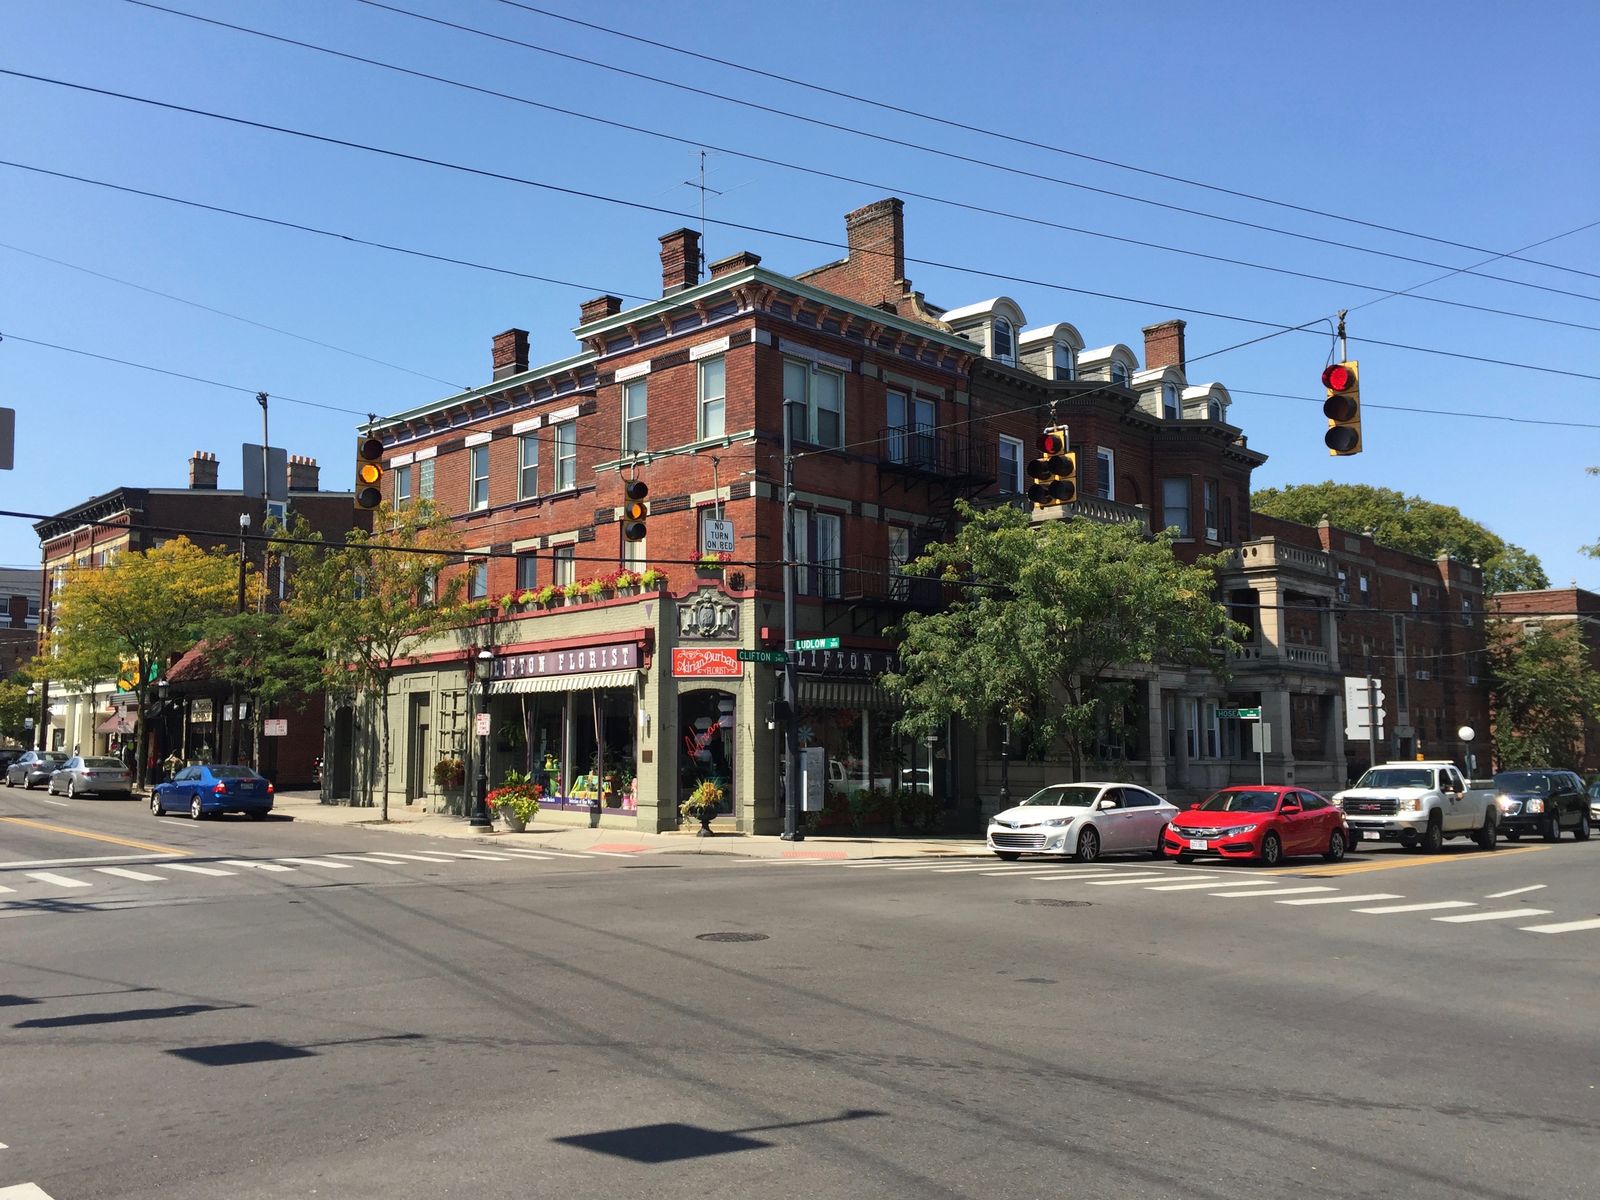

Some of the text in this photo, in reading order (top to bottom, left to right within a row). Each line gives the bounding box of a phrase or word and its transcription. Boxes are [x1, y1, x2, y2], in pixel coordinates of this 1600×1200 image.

[711, 531, 728, 540] TURN
[796, 639, 826, 649] LUDLOW
[677, 650, 738, 673] Adrian Durban
[739, 651, 771, 662] CLIFTON
[798, 650, 873, 671] LIFTON
[494, 648, 629, 677] LIFTON FLORIST
[706, 667, 728, 675] FLORIST
